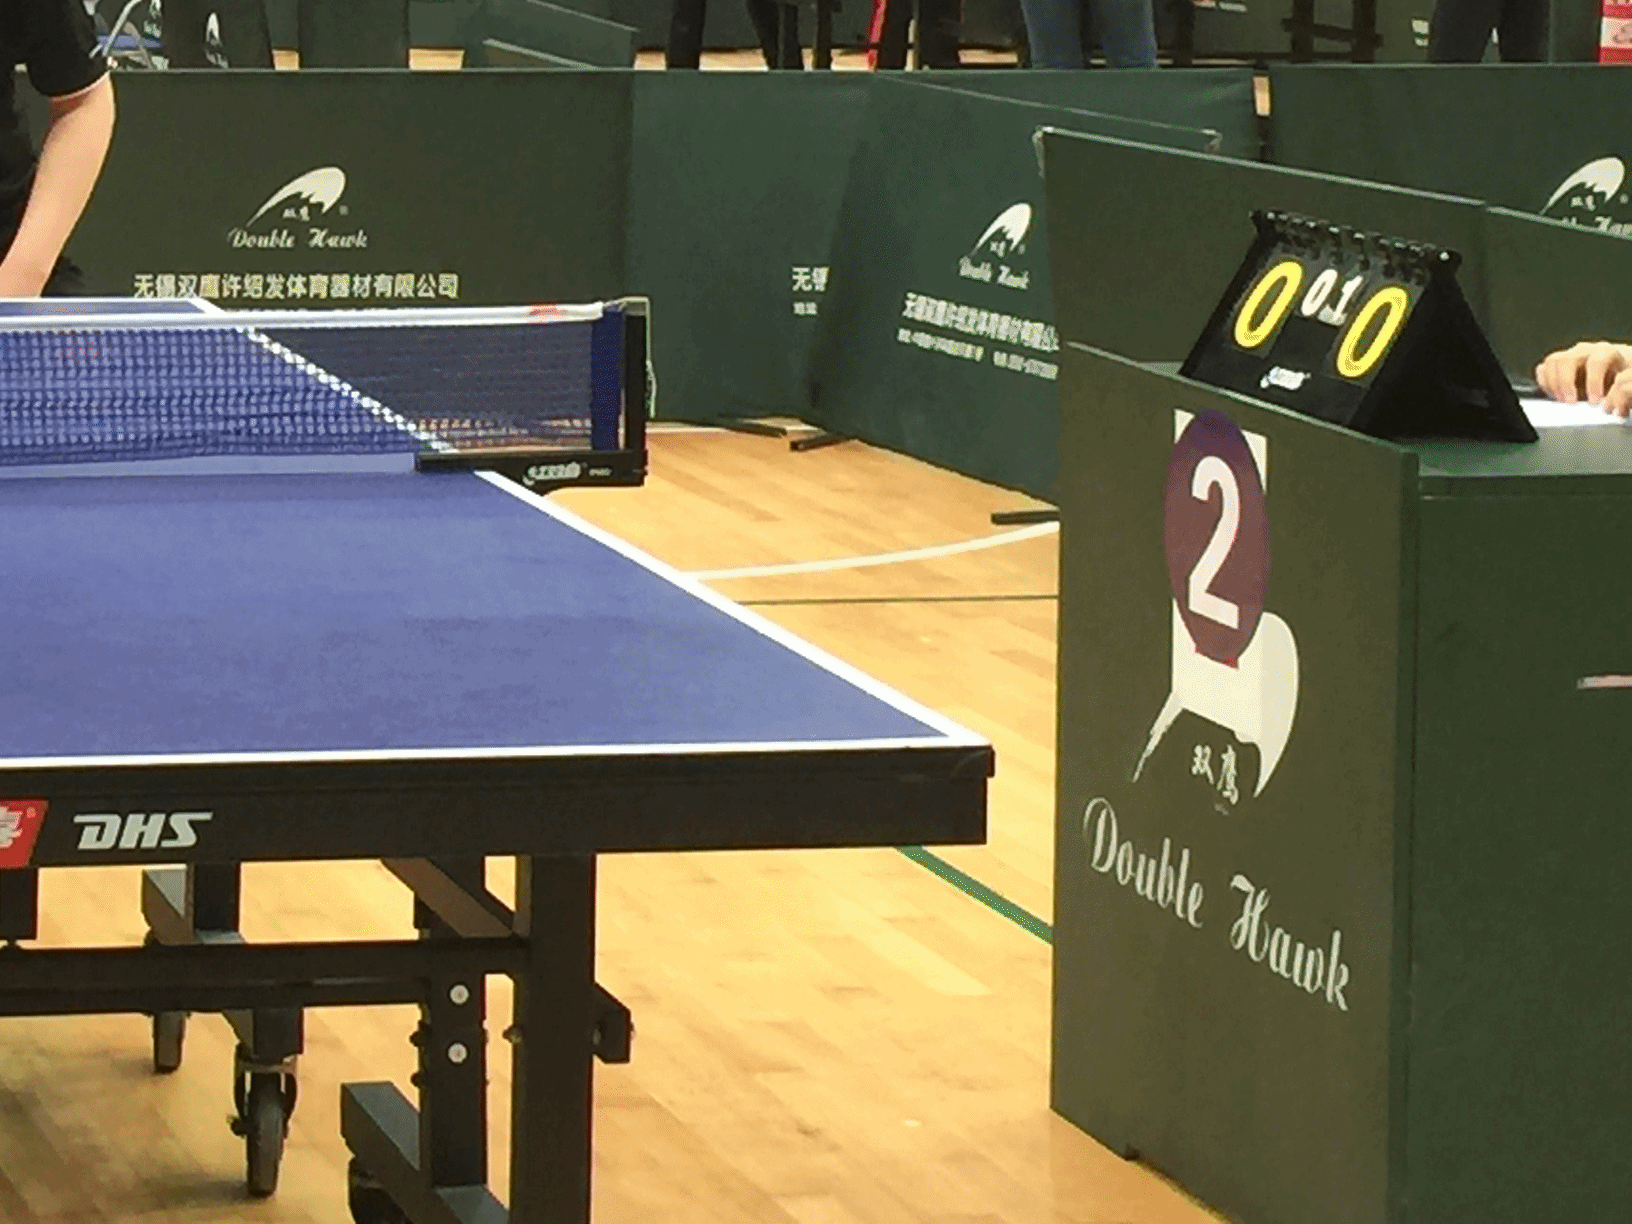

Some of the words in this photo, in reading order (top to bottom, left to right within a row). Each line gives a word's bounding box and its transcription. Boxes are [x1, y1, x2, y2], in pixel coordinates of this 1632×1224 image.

[227, 227, 296, 248] Double
[308, 227, 368, 248] Hawk
[1188, 455, 1240, 629] 2
[72, 811, 213, 850] DHS
[1082, 796, 1204, 929] Double
[1229, 874, 1350, 1012] Hawk
